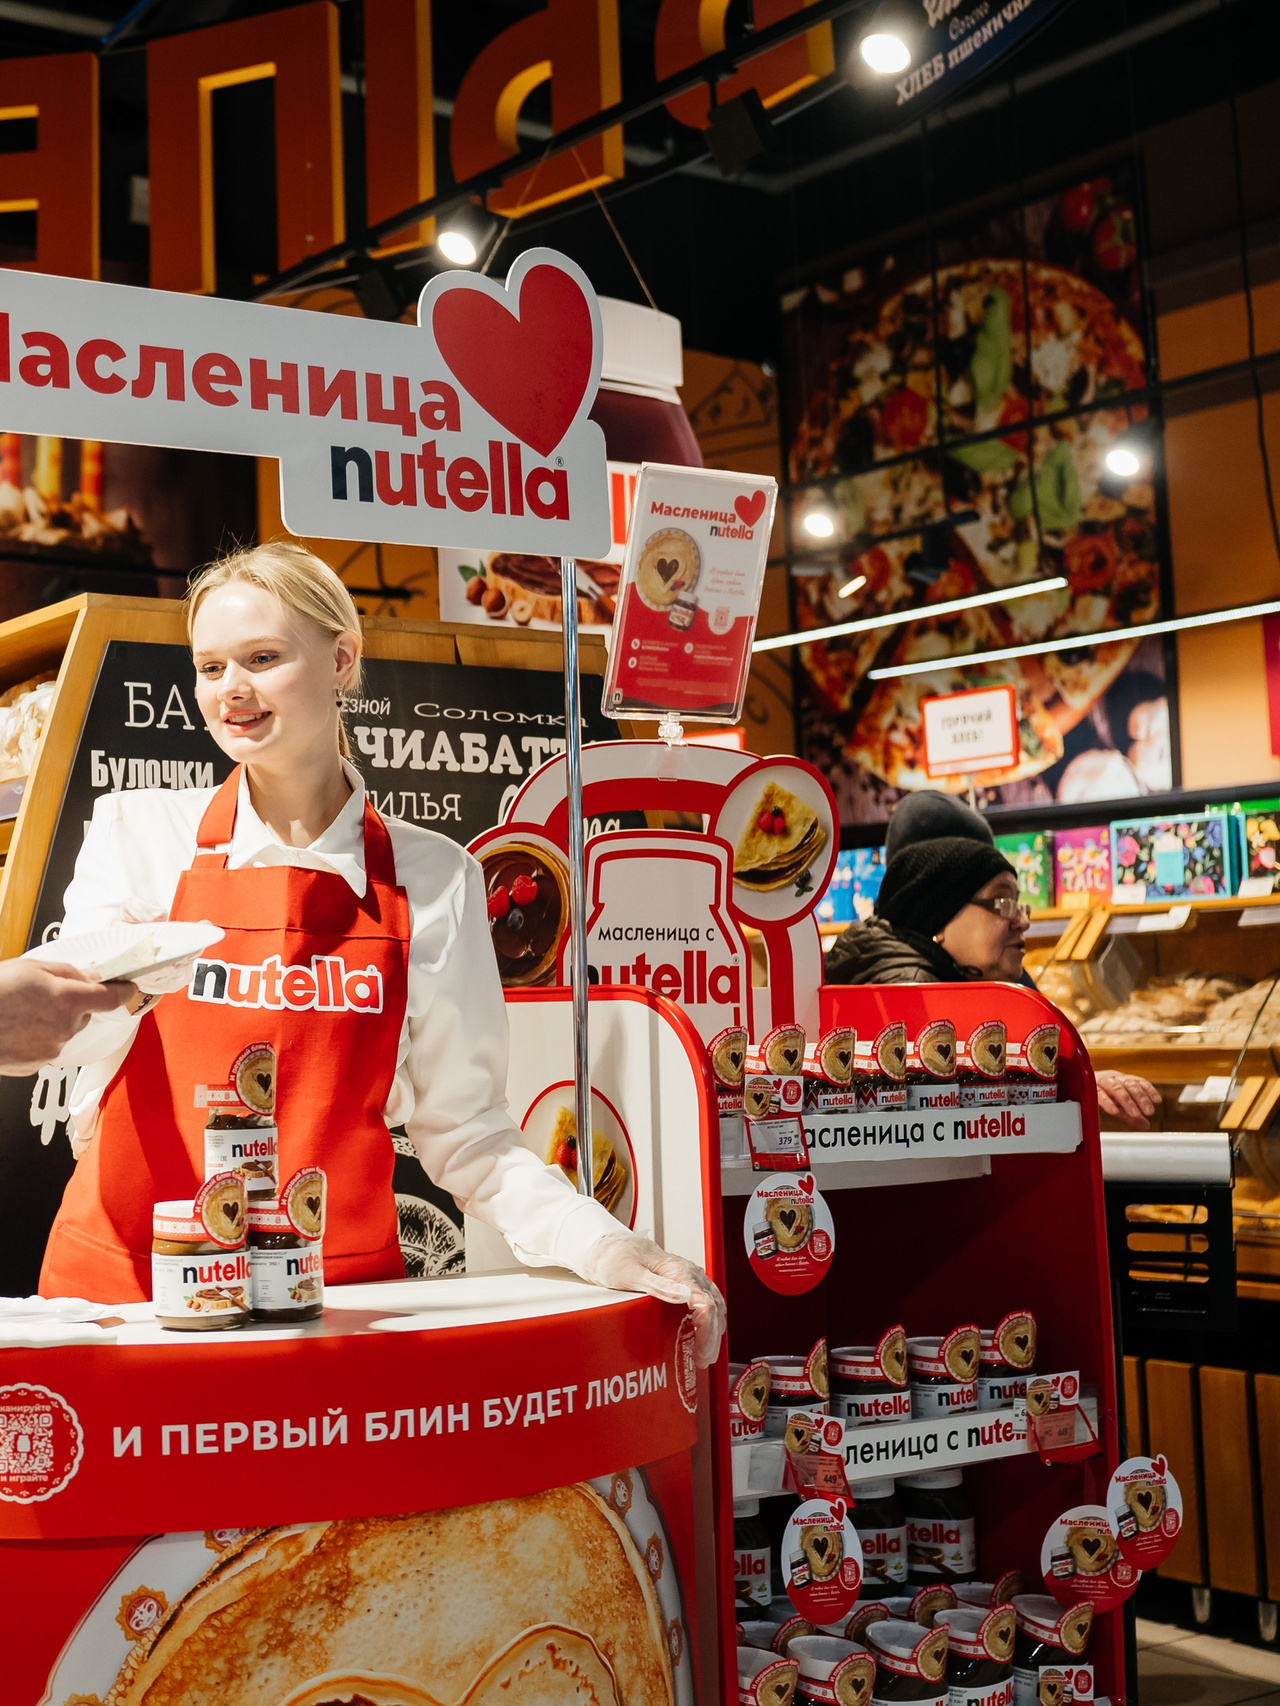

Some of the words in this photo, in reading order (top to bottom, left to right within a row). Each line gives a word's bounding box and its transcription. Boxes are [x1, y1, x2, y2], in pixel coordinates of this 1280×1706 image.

[895, 52, 945, 106] ХЛЕБ
[331, 439, 570, 521] nutella
[650, 501, 737, 524] Масленица
[709, 524, 755, 541] nutella
[340, 697, 391, 716] ЕЗНОЙ
[941, 707, 994, 729] ГОРЯЧИЙ
[353, 725, 567, 776] ЧИАБАТ
[366, 790, 462, 822] ИЛЬЯ
[597, 926, 700, 945] масленица
[706, 926, 715, 942] с
[192, 956, 381, 1010] nutella
[822, 1092, 853, 1107] nutella
[881, 1089, 906, 1104] nutella
[979, 1088, 1005, 1100] nutella
[1032, 1087, 1057, 1099] nutella
[718, 1096, 743, 1110] utella
[804, 1121, 925, 1149] асленица
[933, 1121, 945, 1142] с
[953, 1110, 1026, 1141] nutella
[778, 1136, 793, 1146] 379
[756, 1189, 803, 1199] Масленица
[286, 1250, 324, 1276] nute
[937, 1381, 979, 1406] nutell
[989, 1380, 1027, 1399] nute
[113, 1425, 142, 1458] И
[161, 1407, 348, 1456] ПЕРВЫЙ
[365, 1402, 470, 1442] БЛИН
[483, 1384, 578, 1428] БУДЕТ
[585, 1362, 668, 1410] ЛЮБИМ
[846, 1395, 910, 1417] nutella
[844, 1432, 938, 1467] леница
[946, 1430, 959, 1450] с
[9, 1473, 49, 1483] играйте
[823, 1474, 837, 1484] 449
[1114, 1472, 1157, 1483] Масленица
[792, 1516, 835, 1526] Масленица
[1059, 1518, 1110, 1527] Маслениц
